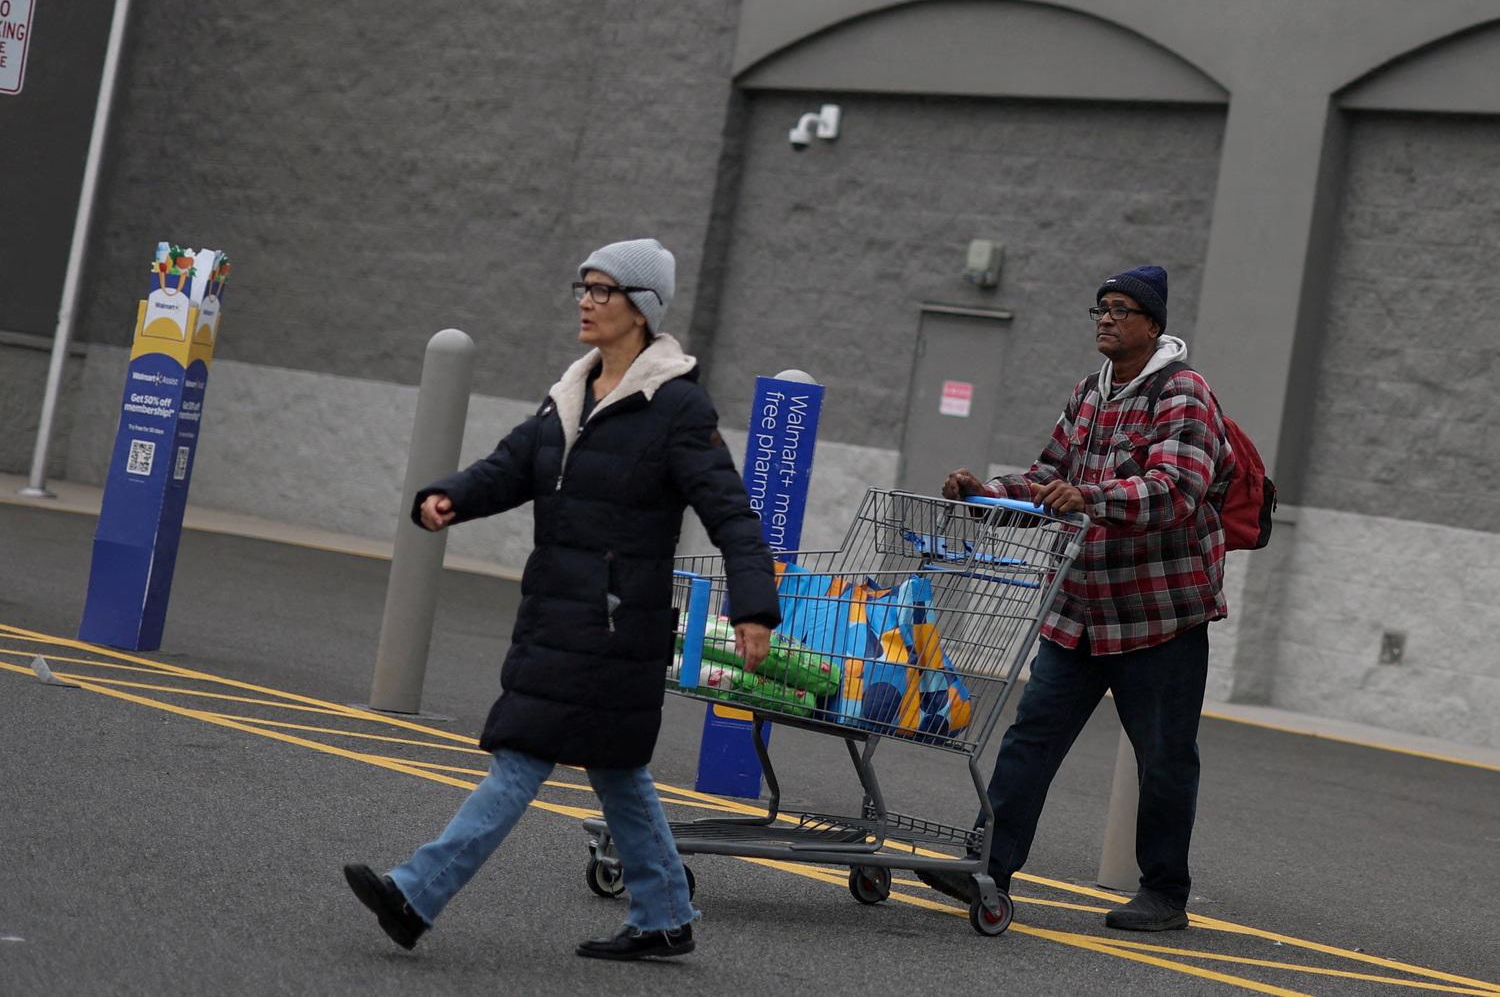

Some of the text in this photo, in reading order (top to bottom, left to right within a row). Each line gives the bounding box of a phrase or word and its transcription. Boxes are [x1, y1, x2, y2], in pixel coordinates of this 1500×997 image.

[131, 393, 143, 403] Get
[143, 395, 159, 406] 50%
[160, 397, 173, 407] off
[762, 391, 785, 429] free
[780, 395, 809, 488] Walmart+
